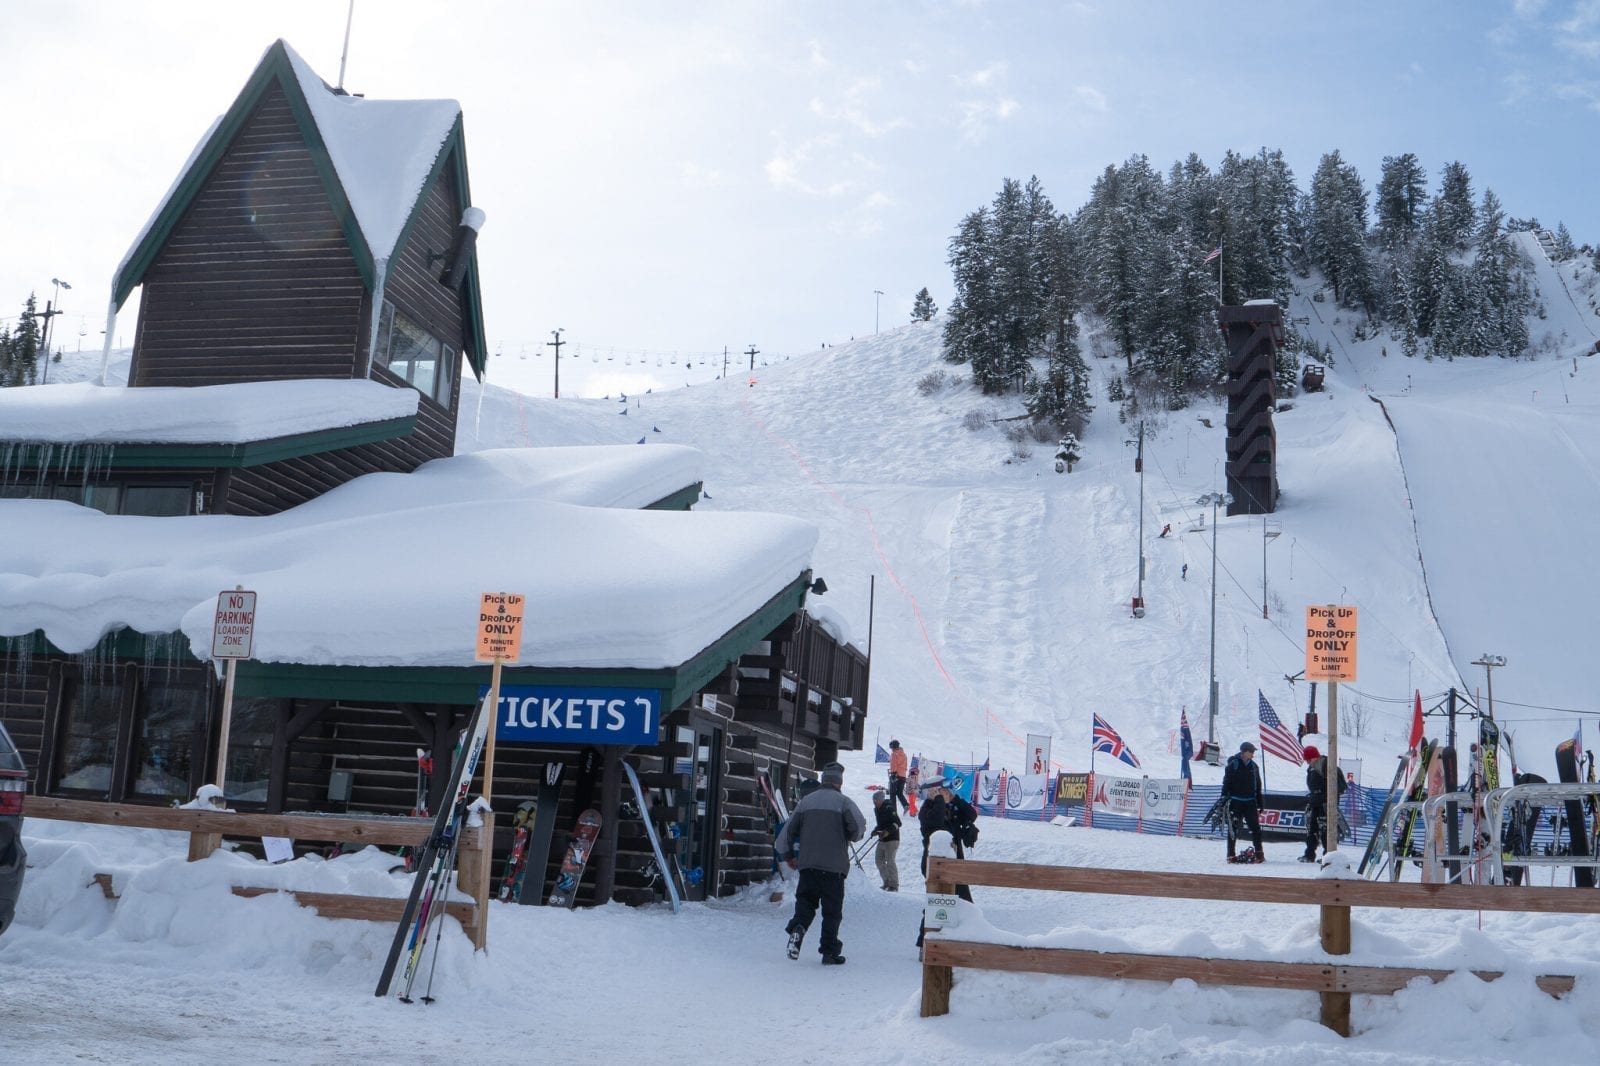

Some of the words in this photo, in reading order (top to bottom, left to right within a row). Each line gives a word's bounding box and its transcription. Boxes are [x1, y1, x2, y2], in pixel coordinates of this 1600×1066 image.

[229, 596, 243, 609] NO
[497, 604, 505, 613] &
[217, 611, 252, 625] PARKING
[1326, 618, 1336, 628] &
[217, 625, 249, 635] LOADING
[485, 624, 515, 634] ONLY
[223, 636, 242, 646] ZONE
[1313, 640, 1349, 651] ONLY
[1058, 776, 1087, 801] STINGER
[1114, 780, 1141, 789] COLORADO
[1109, 788, 1124, 797] EVENT
